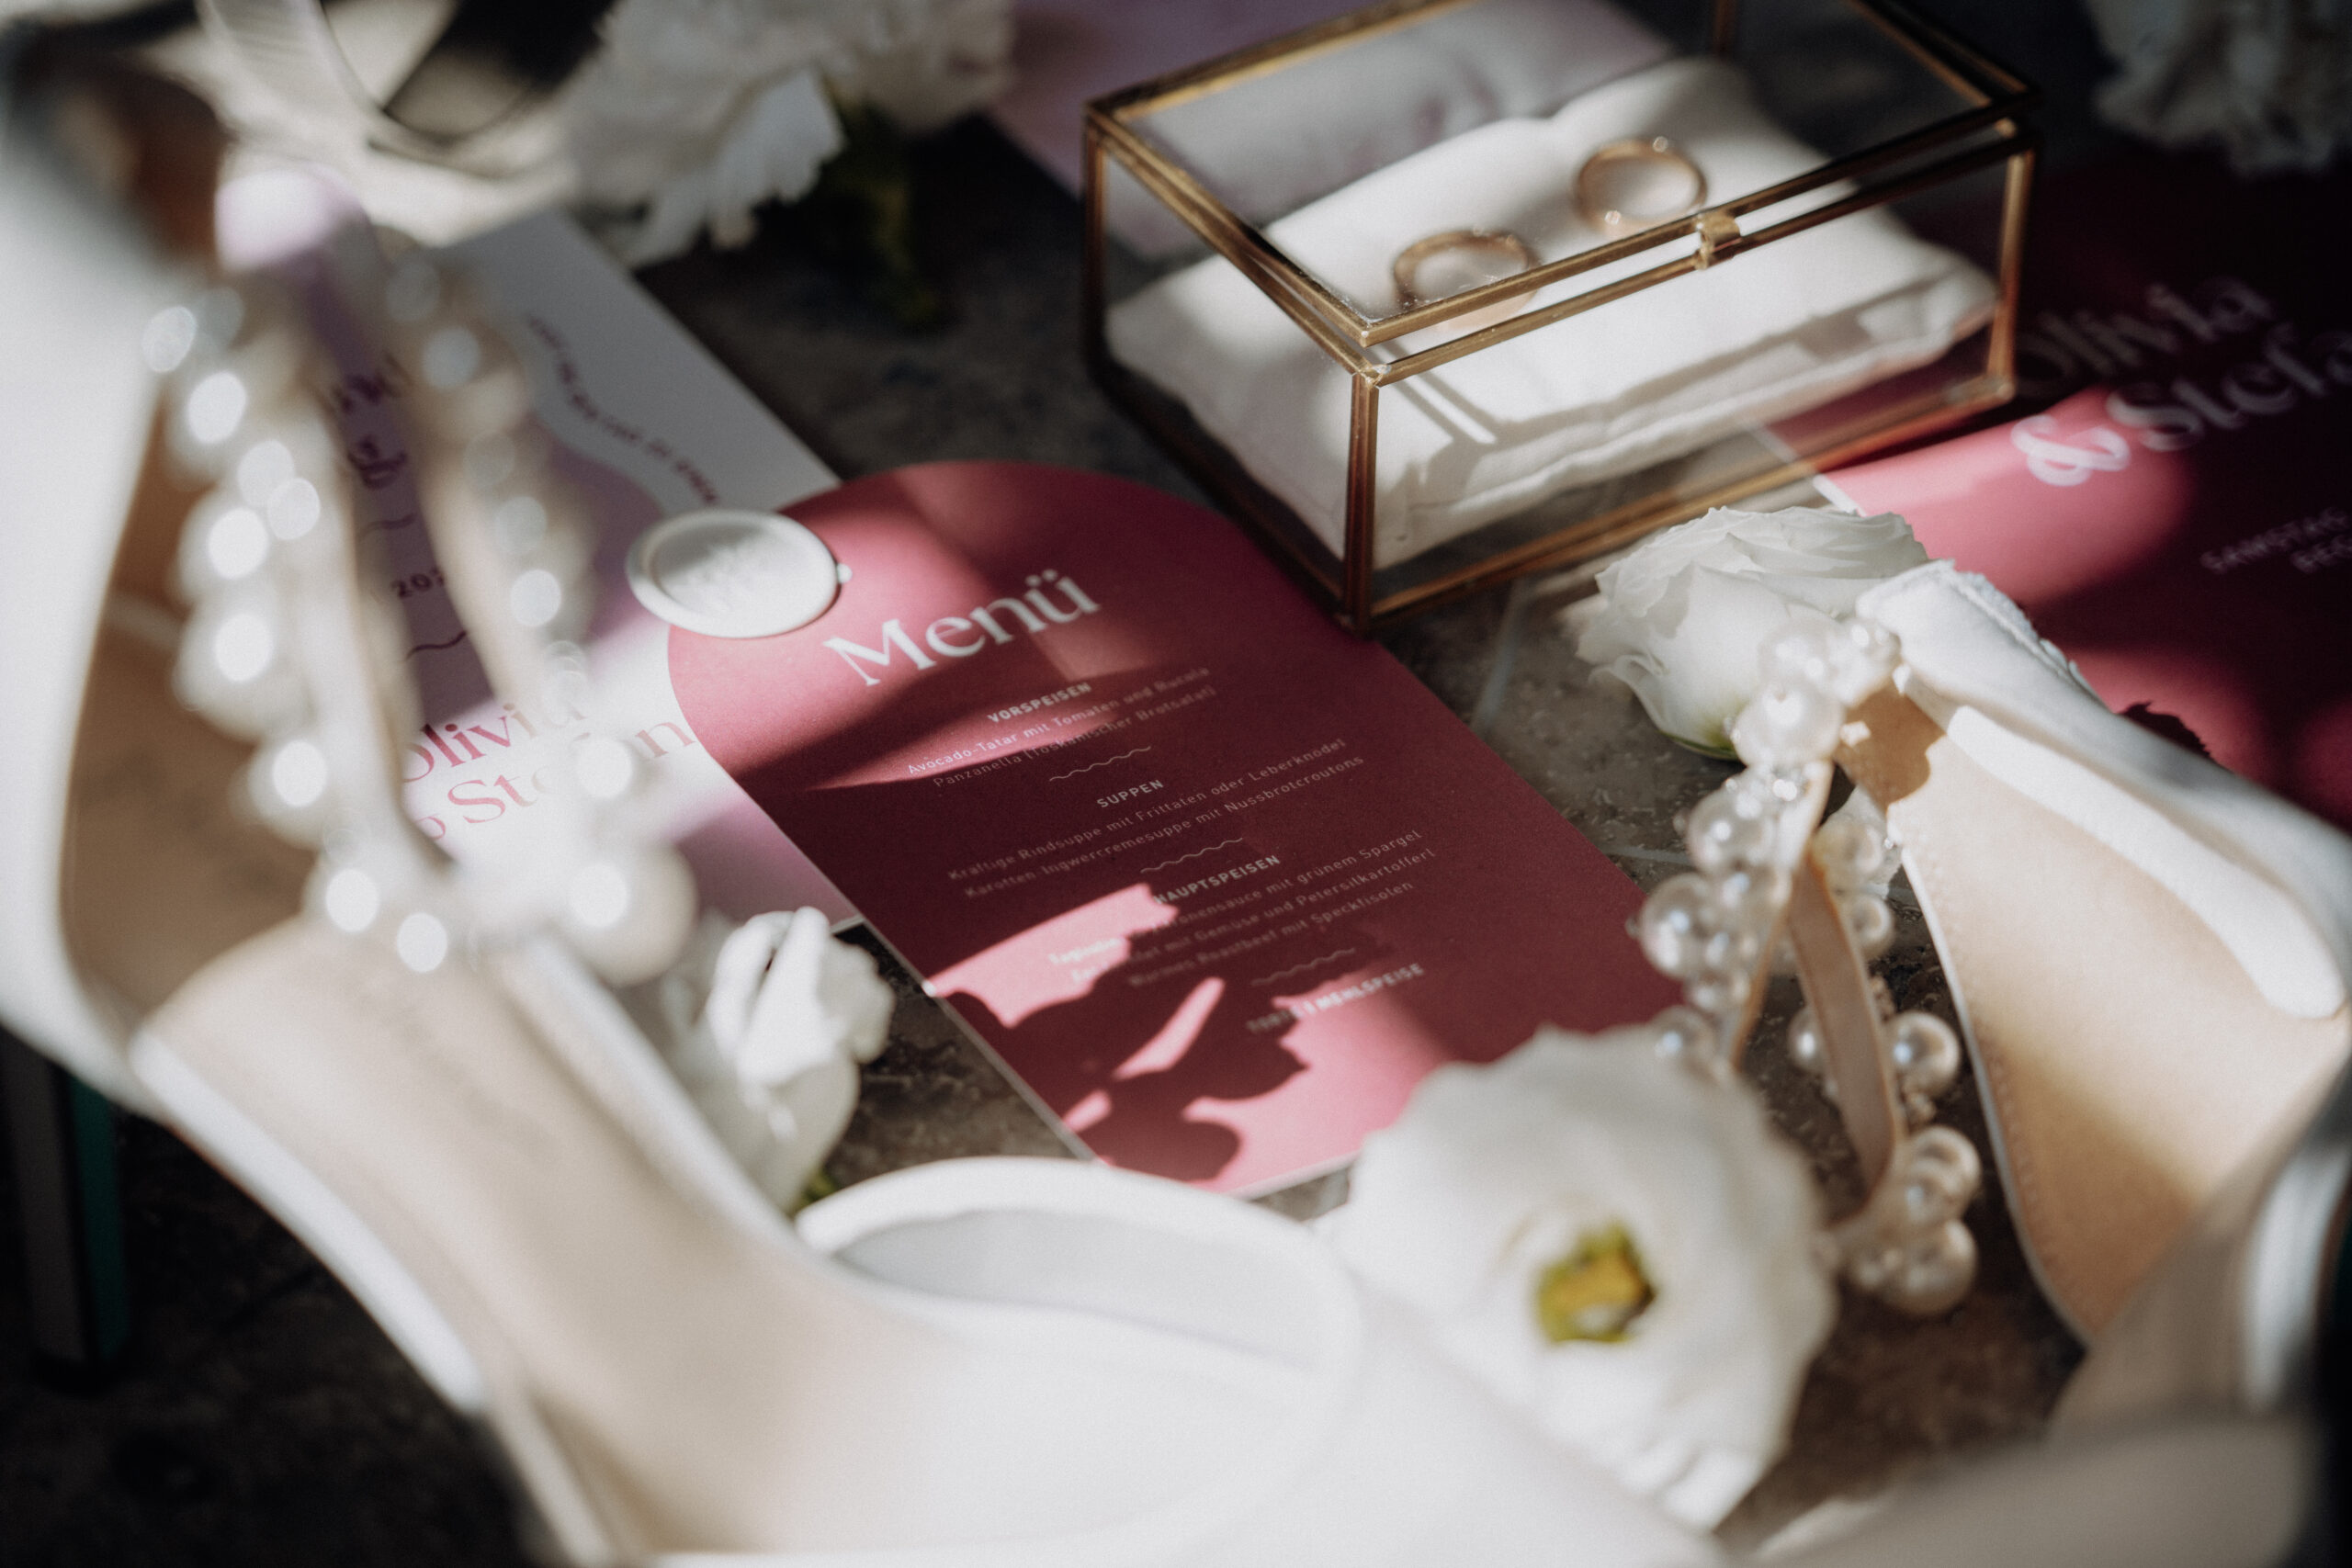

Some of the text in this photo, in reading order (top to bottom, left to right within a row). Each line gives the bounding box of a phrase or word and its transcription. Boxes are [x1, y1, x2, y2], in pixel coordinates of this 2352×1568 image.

[2009, 412, 2131, 487] &
[823, 568, 1101, 686] Menü
[907, 733, 1018, 775] Avocado-Tatar
[1023, 721, 1051, 739] mit
[1053, 697, 1121, 728] Tomaten
[987, 682, 1092, 724] VORSPEISEN
[447, 720, 696, 824] Sten
[933, 752, 1023, 787] Panzanella
[1095, 778, 1165, 808] SUPPEN
[1194, 807, 1224, 825] mit
[1224, 755, 1365, 813] Nussbrotcroutons
[1017, 827, 1102, 861] Rindsuppe
[1106, 816, 1135, 832] mit
[1135, 791, 1208, 822] Frittaten
[1210, 777, 1246, 796] oder
[1153, 854, 1282, 905] HAUPTSPEISEN
[1266, 878, 1295, 895] mit
[1296, 854, 1359, 886] grünem
[1358, 829, 1424, 861] Spargel
[1263, 901, 1295, 919] und
[1281, 919, 1309, 936] mit
[1310, 880, 1415, 925] Speckfisolen
